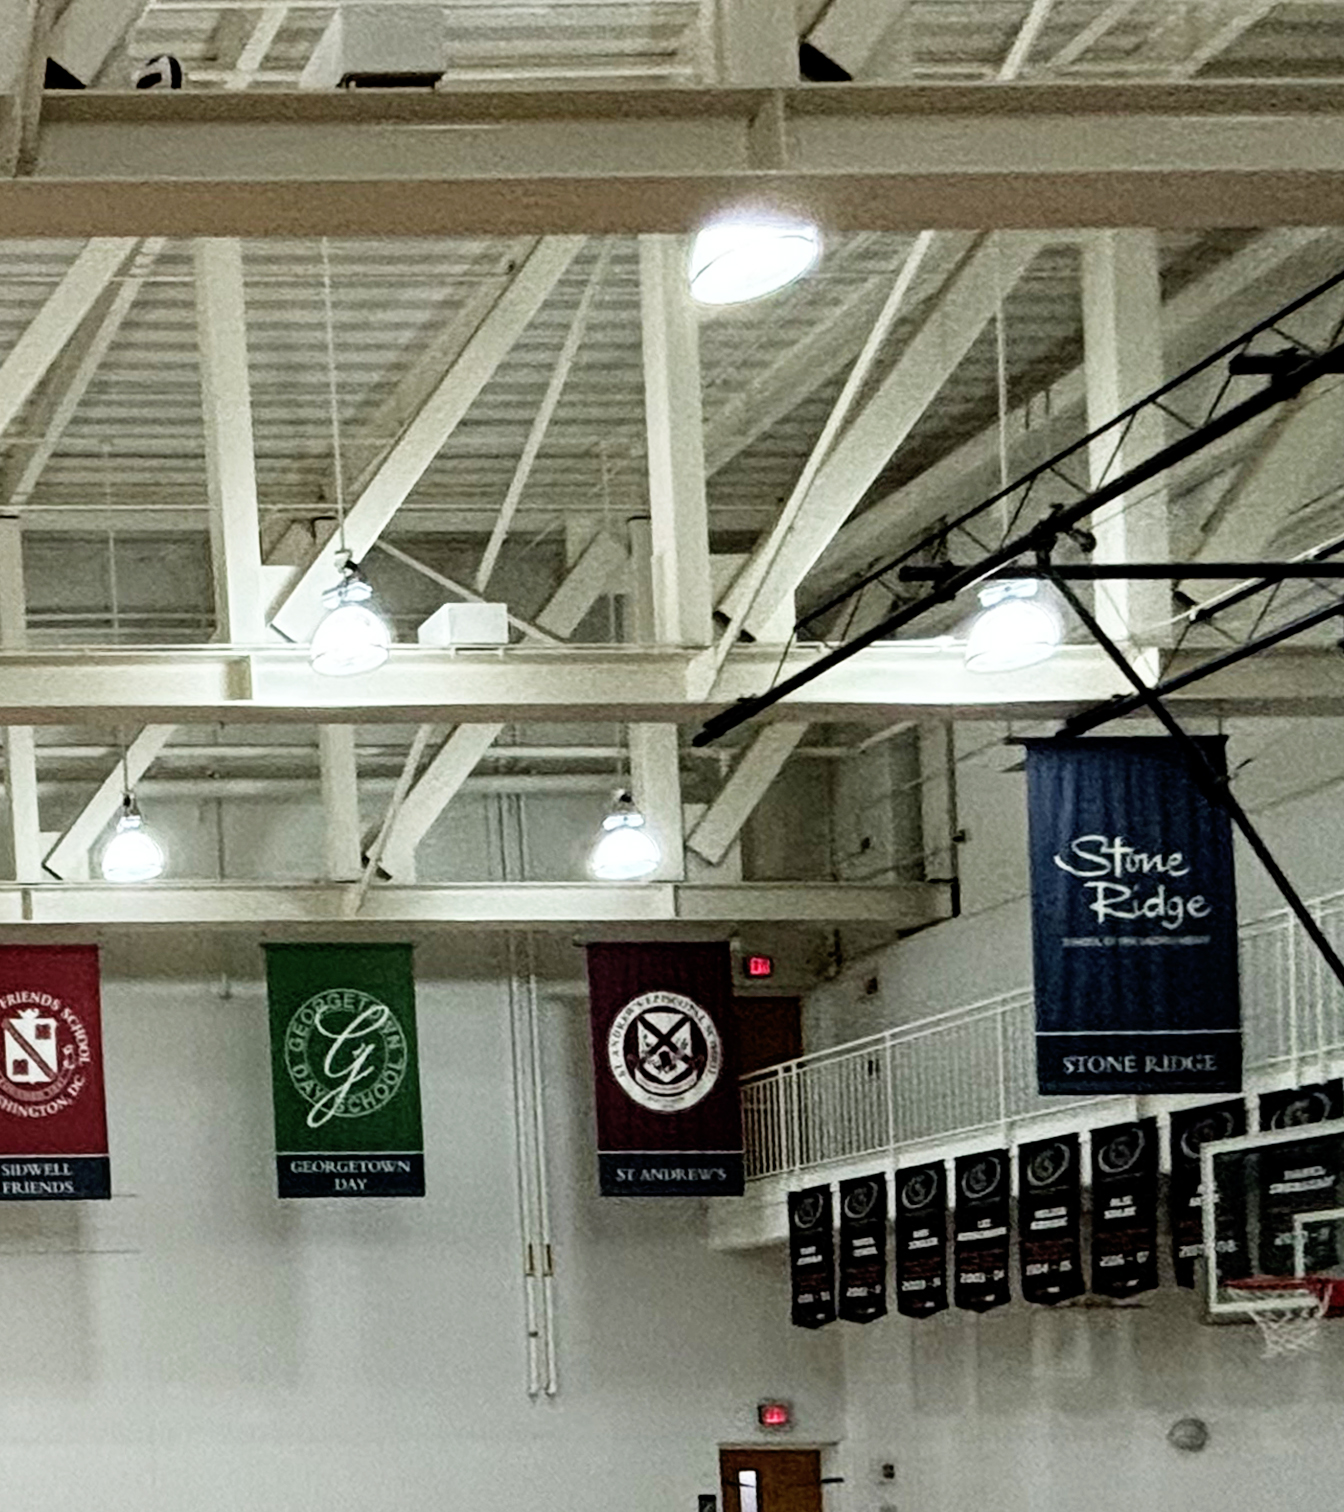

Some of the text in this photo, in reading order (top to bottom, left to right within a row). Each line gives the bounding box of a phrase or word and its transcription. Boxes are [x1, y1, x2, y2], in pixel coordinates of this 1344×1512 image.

[1053, 834, 1191, 878] Stone
[1083, 881, 1212, 930] Ridge
[60, 1007, 91, 1065] SCHOOL
[1062, 1054, 1218, 1074] STONE RIDGE
[67, 1074, 85, 1098] DC
[0, 1163, 73, 1177] SIDWELL
[290, 1160, 411, 1174] GEORGETOWN
[616, 1168, 728, 1182] ST ANDREW'S
[2, 1181, 75, 1195] FRIENDS
[334, 1178, 368, 1191] DAY
